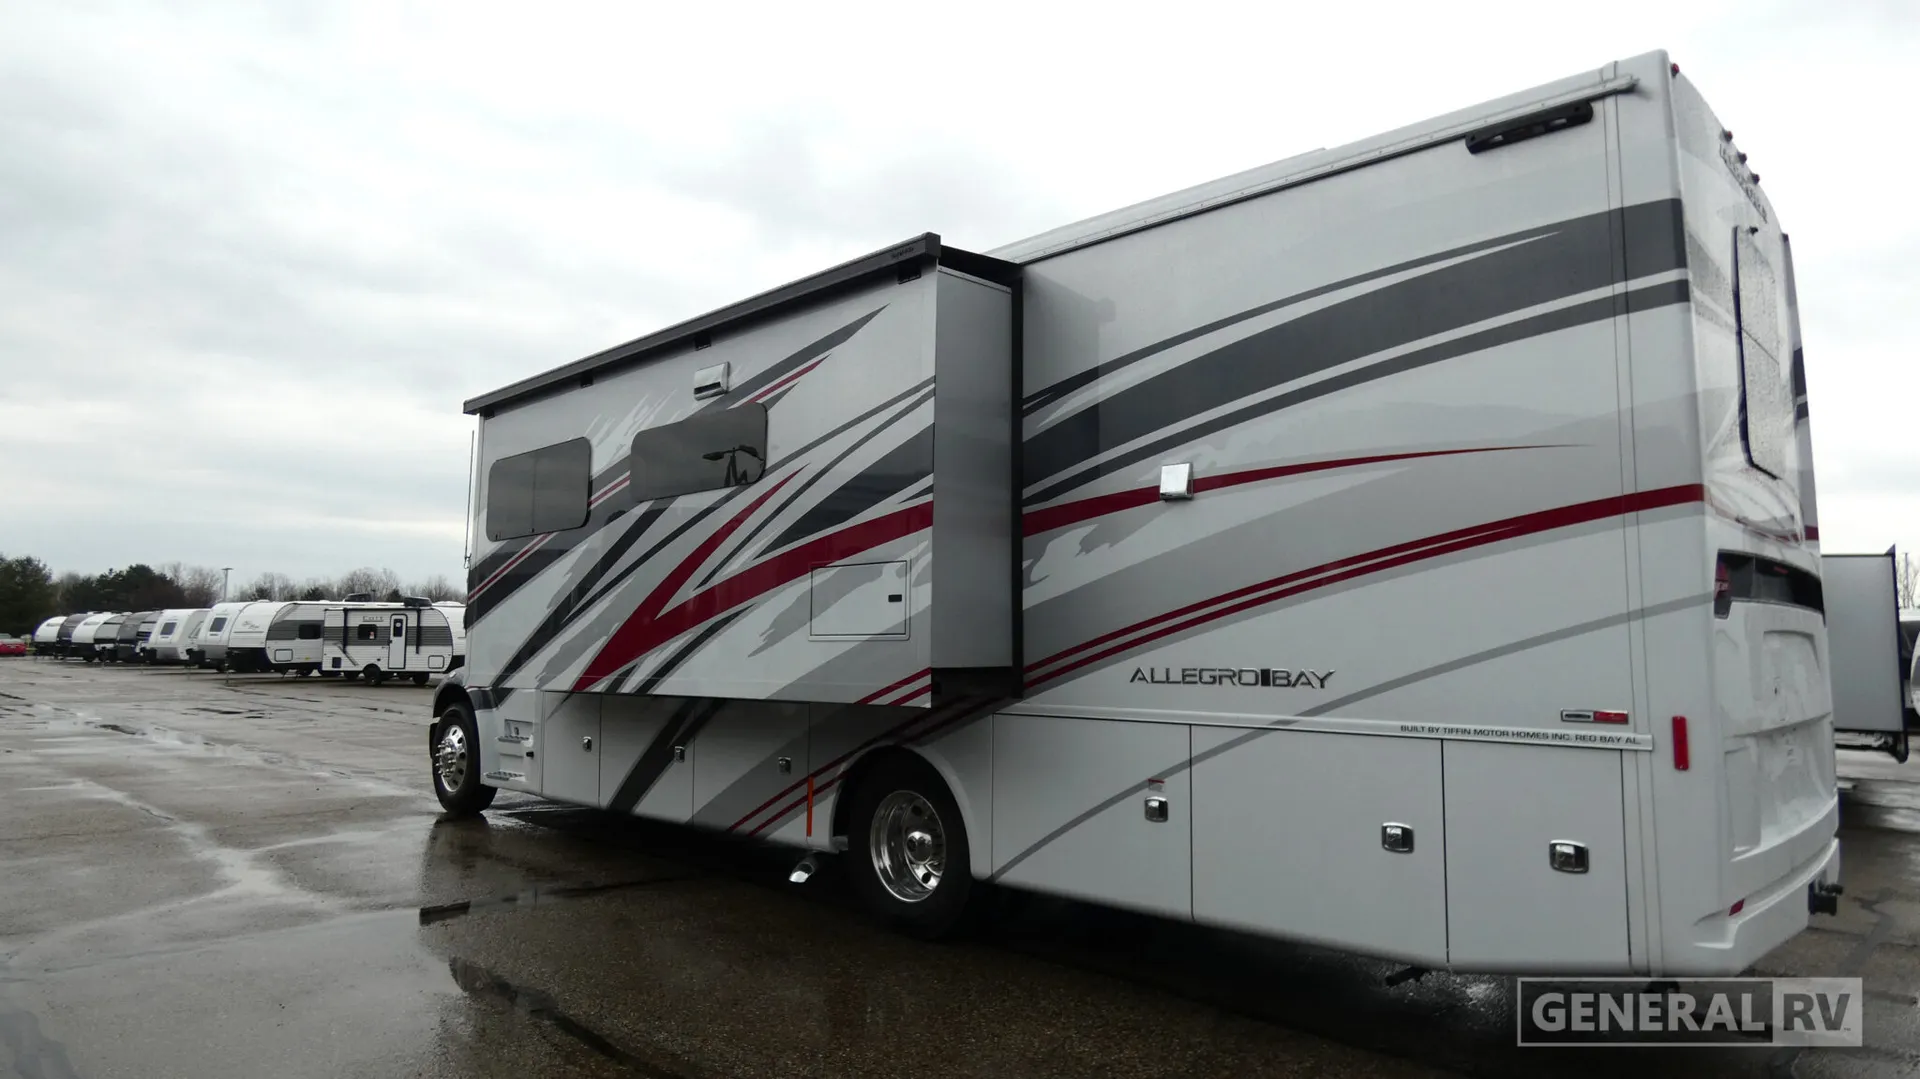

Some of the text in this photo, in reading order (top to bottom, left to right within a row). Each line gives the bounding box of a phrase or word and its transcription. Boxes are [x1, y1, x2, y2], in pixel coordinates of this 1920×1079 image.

[1130, 668, 1336, 689] ALLEGRO BAY
[1400, 725, 1426, 733] BUILT
[1428, 726, 1441, 734] BY
[1443, 727, 1472, 735] TIFFIN
[1473, 728, 1510, 738] MOTOR
[1511, 730, 1550, 740] HOMES
[1551, 732, 1573, 741] INC.
[1575, 734, 1598, 742] RED
[1600, 735, 1621, 743] BAY
